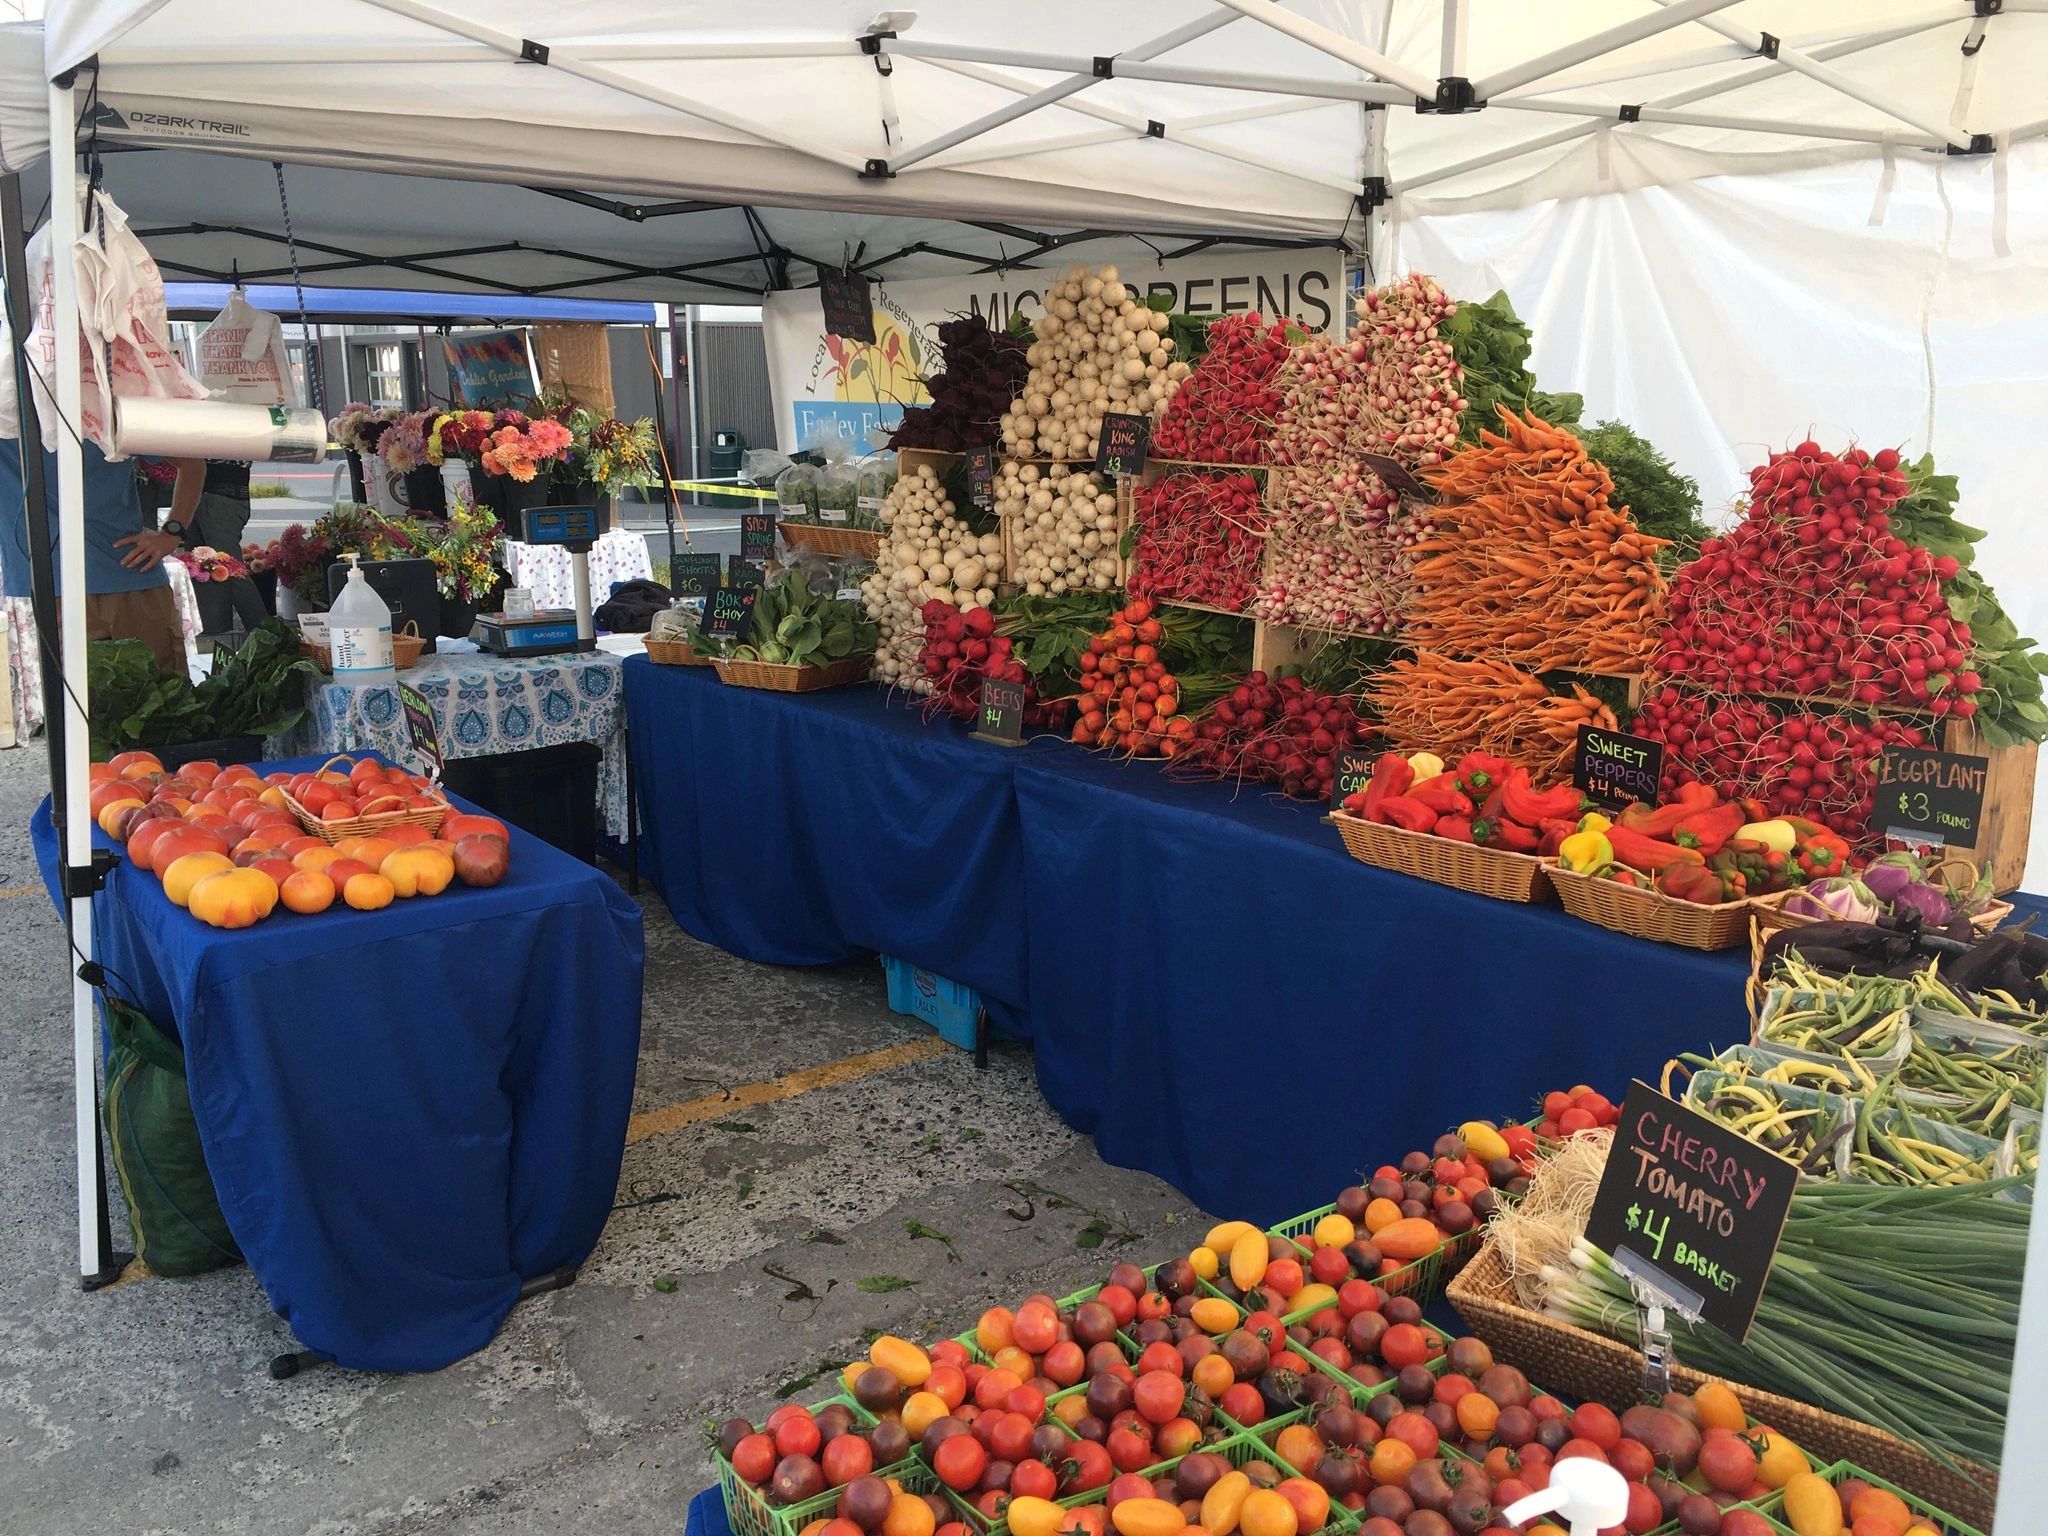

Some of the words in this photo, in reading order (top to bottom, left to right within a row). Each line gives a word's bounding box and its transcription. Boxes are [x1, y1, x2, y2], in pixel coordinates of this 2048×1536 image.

[130, 111, 195, 129] OZARK
[198, 120, 251, 137] TRAIL
[143, 126, 185, 136] OUTDOOR
[203, 360, 246, 374] THANK
[248, 360, 277, 374] YOU
[805, 334, 828, 396] Local
[1111, 430, 1136, 446] KING
[1106, 446, 1136, 457] RADISH
[1108, 456, 1121, 472] $3
[746, 517, 768, 532] SPICY
[747, 533, 772, 546] SPRING
[678, 564, 717, 576] SHOOTS
[681, 577, 702, 593] $6
[715, 590, 742, 609] BOK
[713, 608, 745, 621] CHOY
[713, 620, 728, 631] $4
[336, 645, 345, 668] hand
[344, 629, 352, 668] sanitizer
[984, 682, 1021, 711] BEETS
[985, 706, 1002, 728] $4
[1587, 733, 1648, 768] SWEET
[1585, 754, 1656, 794] PEPPERS
[1880, 751, 1986, 795] EGGPLANT
[1588, 776, 1609, 797] $4
[1614, 787, 1639, 803] POUND
[1899, 791, 1930, 822] $3
[1936, 811, 1971, 830] POUND
[1636, 1111, 1767, 1211] CHERRY
[1630, 1145, 1735, 1238] TOMATO
[1625, 1202, 1671, 1260] $4
[1673, 1241, 1742, 1296] BASKET
